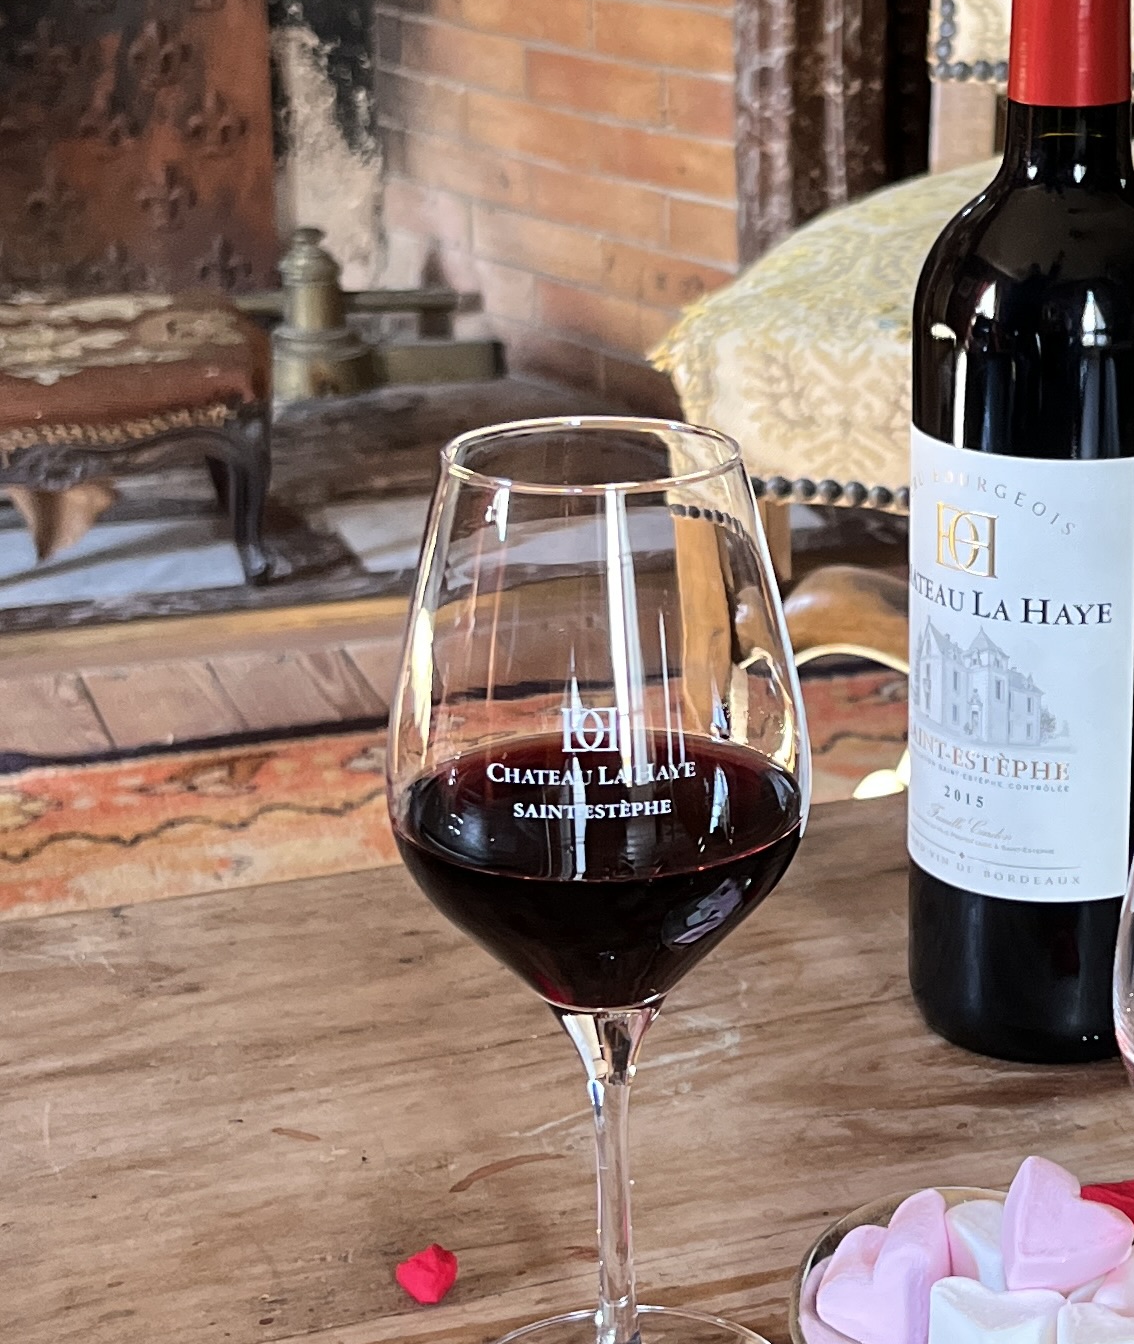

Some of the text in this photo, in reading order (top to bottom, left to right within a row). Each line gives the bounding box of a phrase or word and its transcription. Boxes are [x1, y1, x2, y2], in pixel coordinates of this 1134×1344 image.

[932, 469, 1077, 536] BOURGEOIS
[1020, 597, 1113, 626] HAYE
[944, 785, 984, 810] 2015
[983, 871, 1081, 886] BORDEAUX
